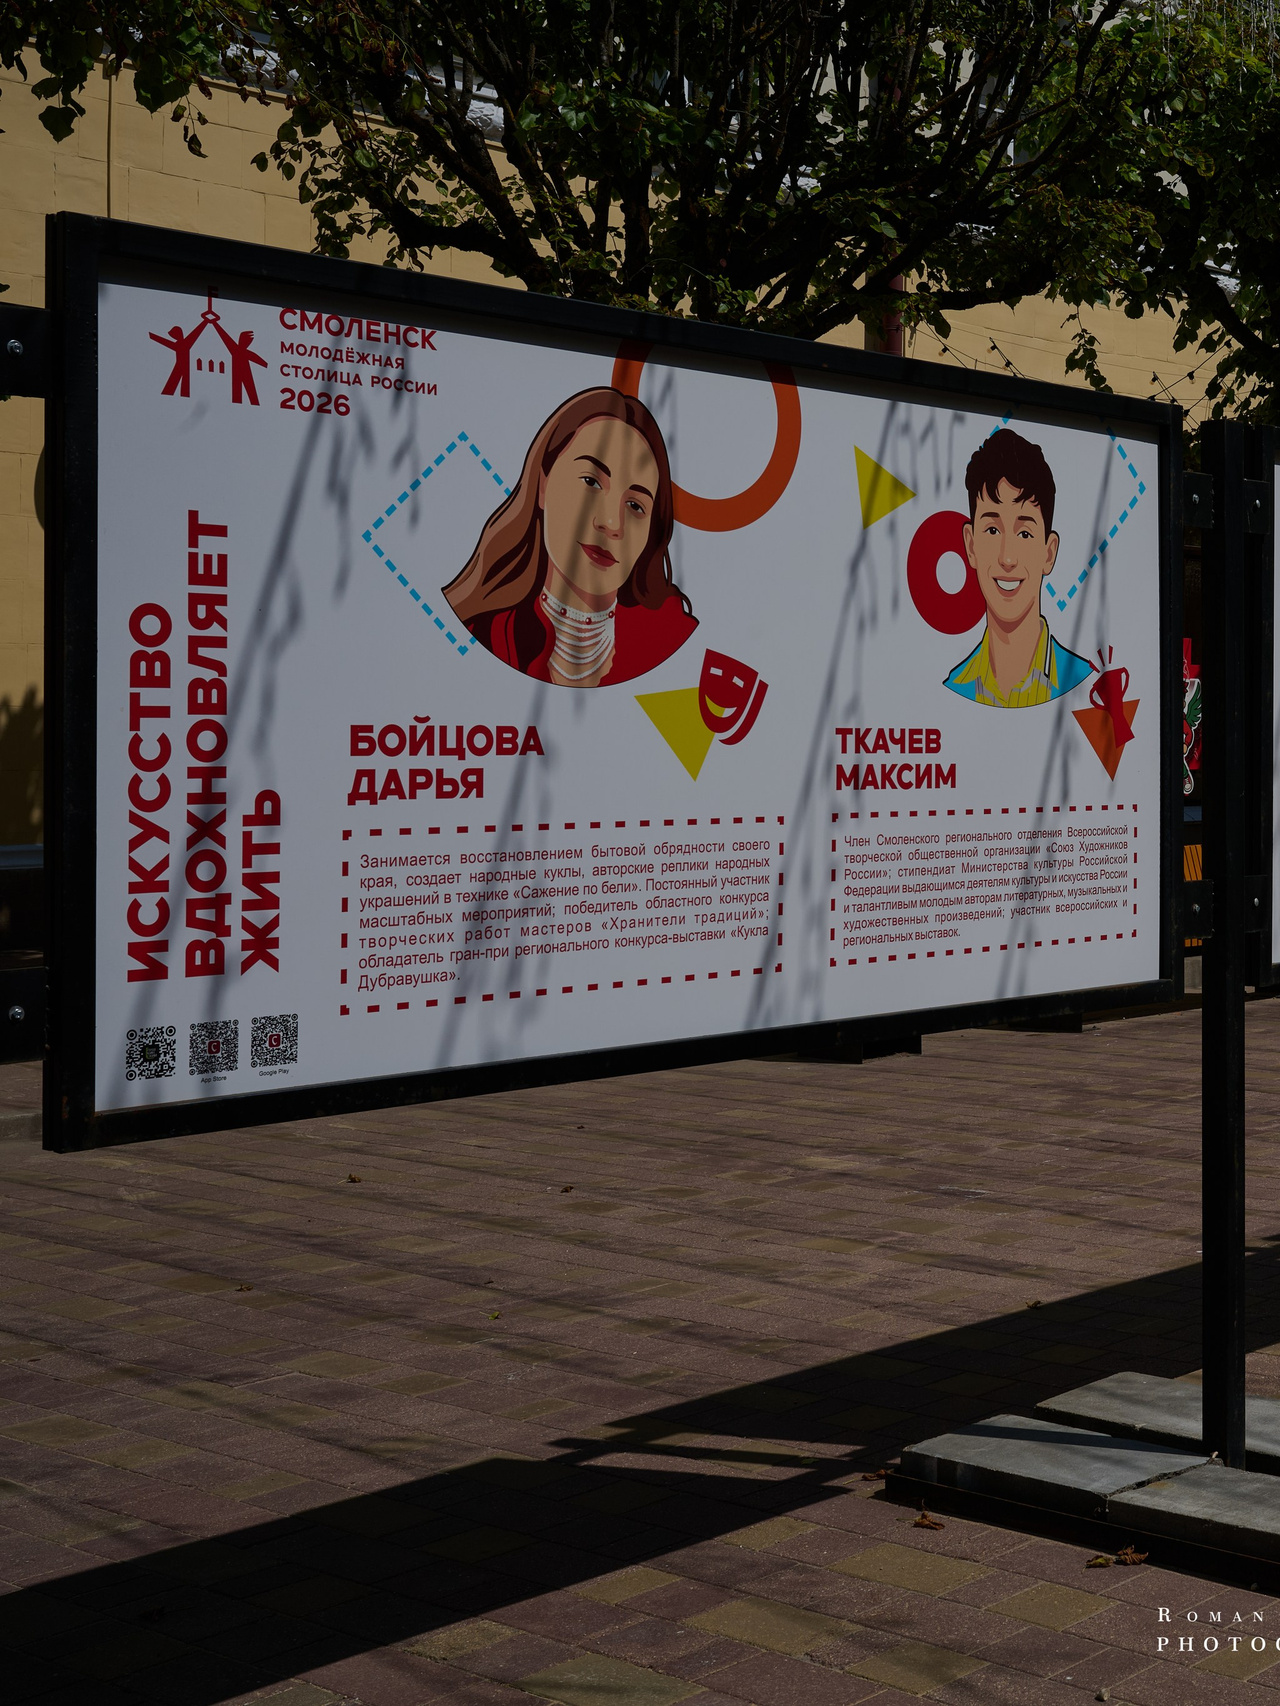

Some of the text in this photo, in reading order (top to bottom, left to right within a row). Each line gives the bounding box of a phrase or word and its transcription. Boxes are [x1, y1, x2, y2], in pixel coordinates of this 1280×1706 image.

[279, 307, 437, 351] СМОЛЕНСК
[280, 343, 405, 370] МОЛОДЁЖНАЯ
[280, 365, 438, 396] СТОЛИЦА РОССИИ
[280, 389, 351, 416] 2026
[185, 510, 231, 977] ВДОХНОВЛЯЕТ
[350, 716, 545, 760] БОЙЦОВА
[835, 728, 942, 754] ТКАЧЕВ
[128, 602, 172, 983] ИСКУССТВО
[347, 768, 484, 805] ДАРЬЯ
[835, 764, 957, 791] МАКСИМ
[844, 834, 870, 847] Член
[1017, 830, 1062, 841] отделения
[360, 840, 769, 869] Занимается восстановлением бытовой обрядности своего
[1033, 859, 1073, 871] культуры
[241, 789, 281, 975] ЖИТЬ
[360, 858, 769, 893] края, создает народные куклы, авторские реплики народных
[843, 884, 899, 898] Федерации
[966, 878, 1009, 890] деятелям
[1011, 875, 1050, 888] культуры
[1051, 875, 1056, 883] и
[1058, 872, 1098, 884] искусства
[1099, 868, 1127, 879] России
[359, 873, 769, 914] украшений в технике «Сажение по бели». Постоянный участник
[843, 905, 849, 913] и
[919, 897, 962, 908] молодым
[964, 894, 1001, 906] авторам
[359, 909, 452, 929] масштабных
[564, 899, 637, 916] победитель
[645, 894, 711, 910] областного
[719, 892, 768, 906] конкурса
[1010, 905, 1050, 919] участник
[1122, 899, 1127, 907] и
[358, 923, 768, 969] обладатель гран-при регионального конкурса-выставки «Кукла
[359, 932, 453, 951] творческих
[464, 924, 509, 945] работ
[520, 922, 591, 937] мастеров
[259, 1069, 278, 1077] Google
